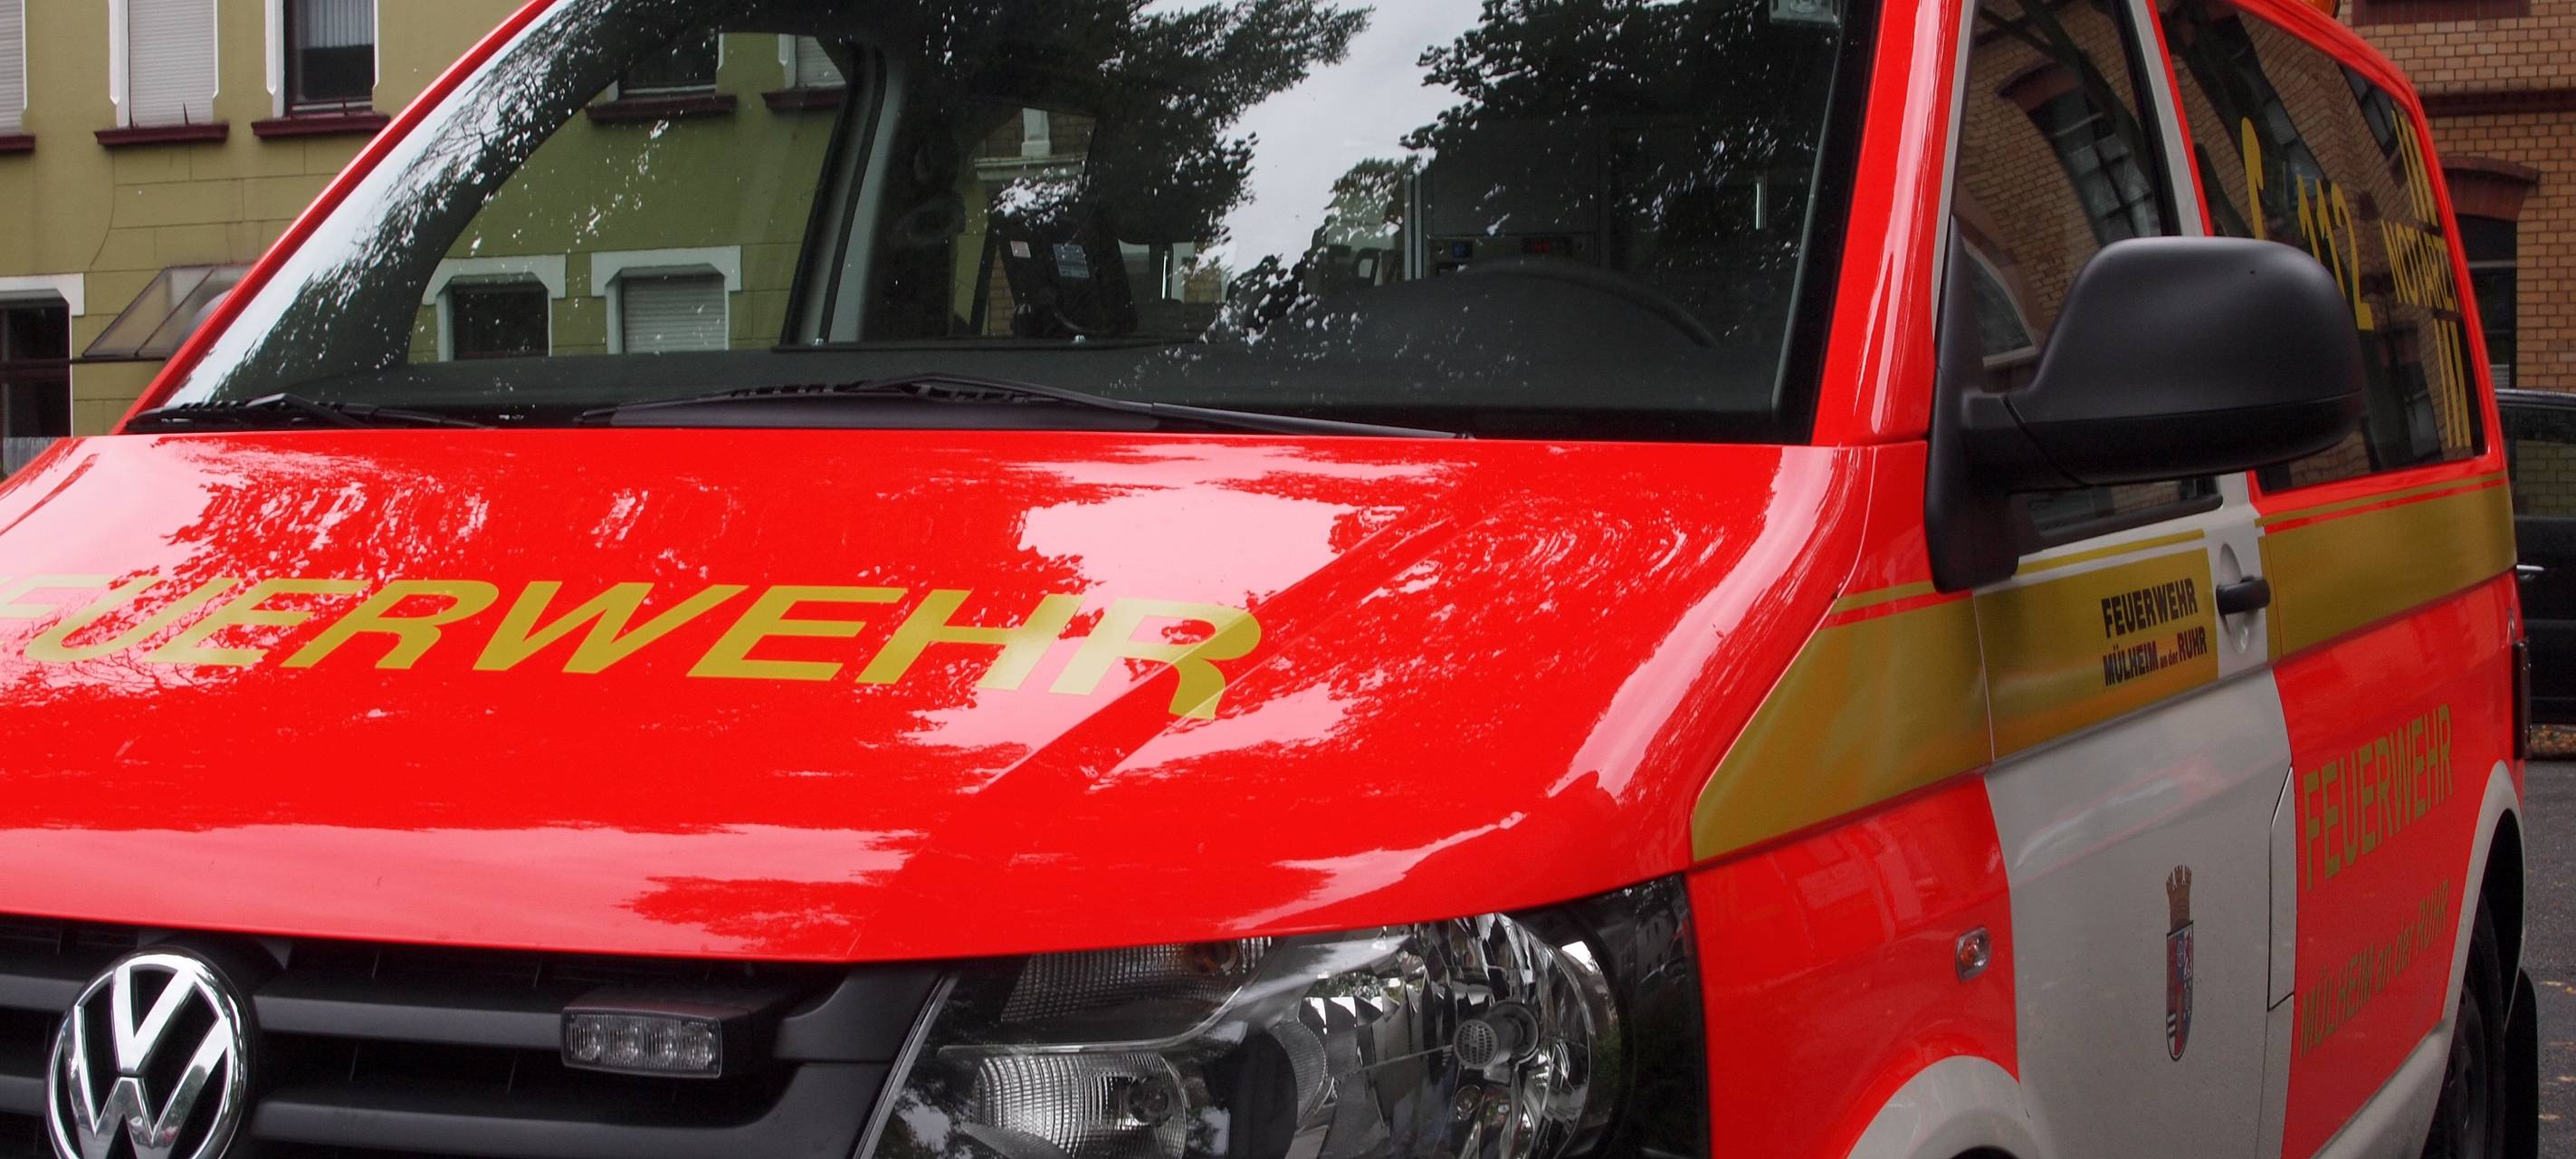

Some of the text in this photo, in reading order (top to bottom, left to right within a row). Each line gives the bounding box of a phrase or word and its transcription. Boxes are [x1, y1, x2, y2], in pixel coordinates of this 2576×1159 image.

[2380, 218, 2460, 313] NOTARZT
[2101, 578, 2198, 638] FEUERWEHR
[2102, 640, 2159, 686] MÜLHEIM
[2176, 626, 2208, 663] RUHR
[2304, 703, 2454, 892] FEUERWEHR
[2299, 878, 2449, 1060] MÜLHEIM an der RUHR
[71, 954, 235, 1159] VW
